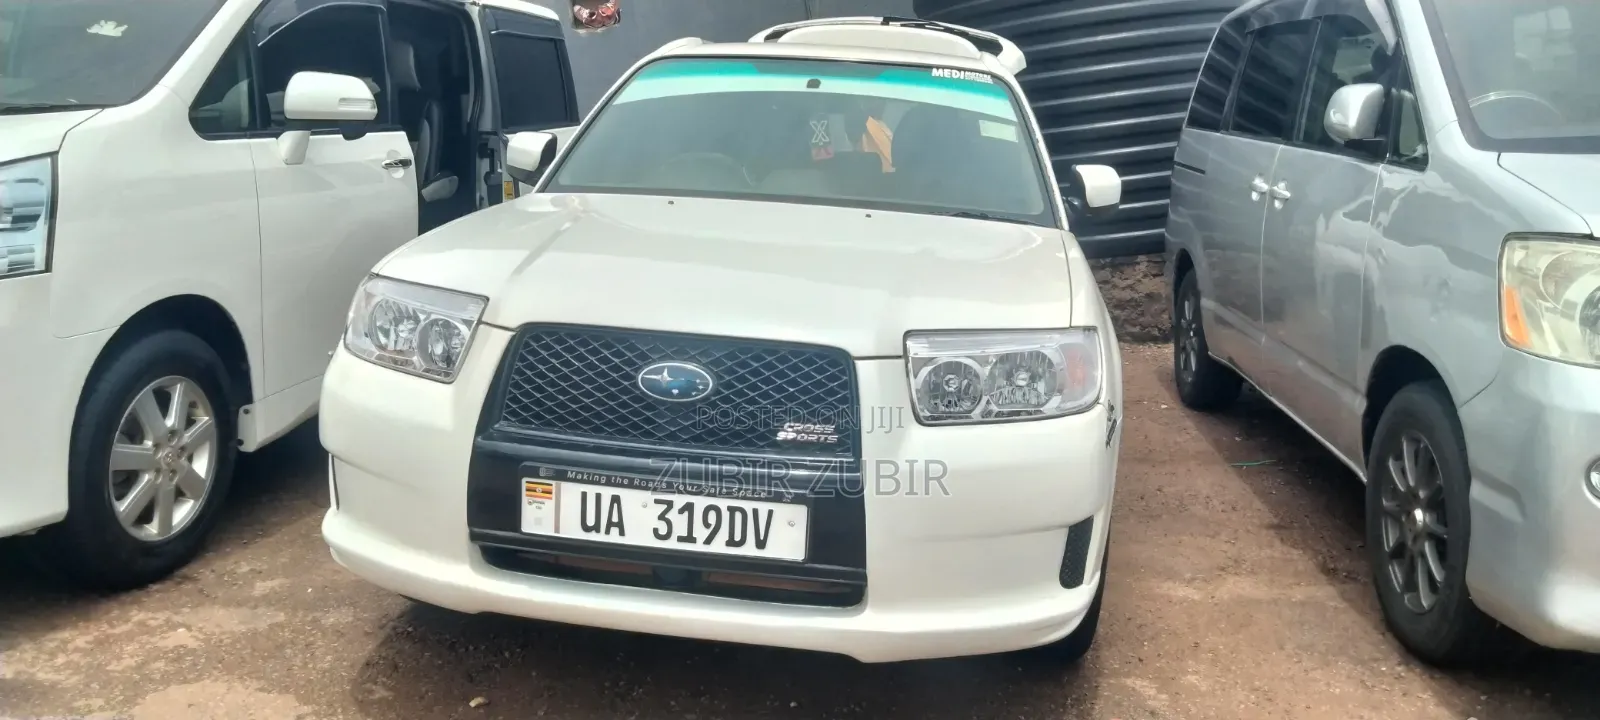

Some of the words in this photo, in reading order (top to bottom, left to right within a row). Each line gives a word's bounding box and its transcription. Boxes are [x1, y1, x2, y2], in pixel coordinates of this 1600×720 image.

[931, 68, 965, 80] MEDI
[783, 422, 836, 433] CROSS
[776, 431, 839, 443] SPORTS
[567, 470, 607, 484] Making
[611, 477, 629, 485] the
[633, 479, 668, 489] Roads
[672, 482, 698, 492] Your
[702, 485, 727, 495] Safe
[732, 487, 767, 498] Space
[580, 490, 626, 537] UA
[652, 498, 774, 550] 319DV
